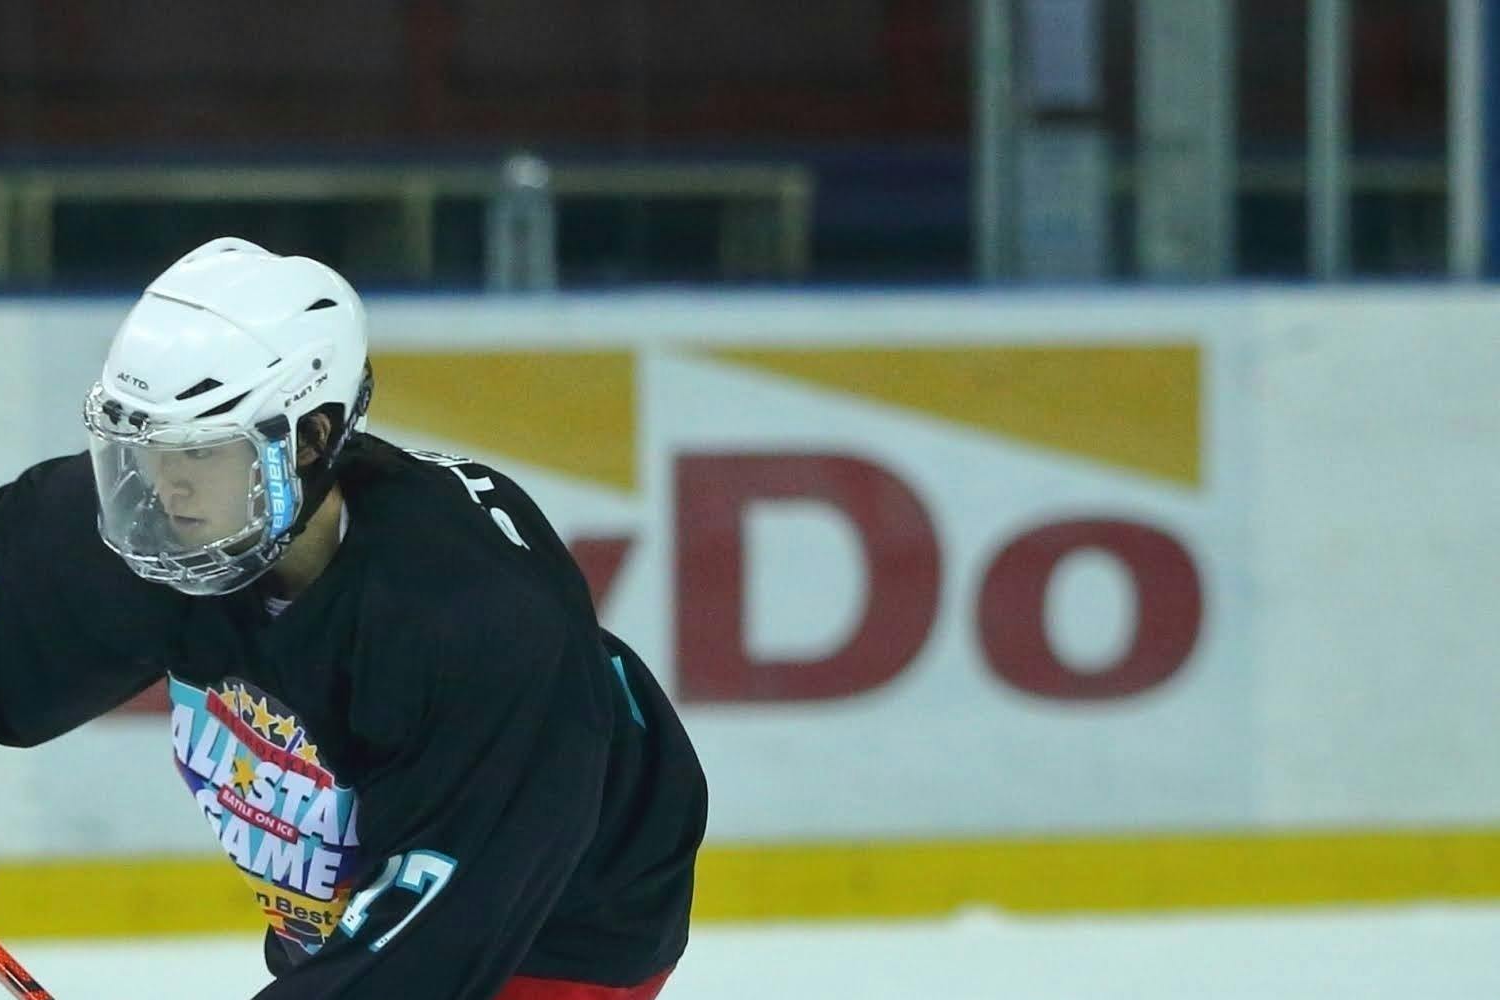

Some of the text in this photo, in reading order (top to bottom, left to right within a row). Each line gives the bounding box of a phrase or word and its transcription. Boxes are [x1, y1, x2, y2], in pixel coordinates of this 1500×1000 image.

[568, 447, 1203, 706] Do
[222, 789, 294, 838] BATTLE ON ICE
[246, 760, 360, 847] STA
[276, 896, 333, 925] Best
